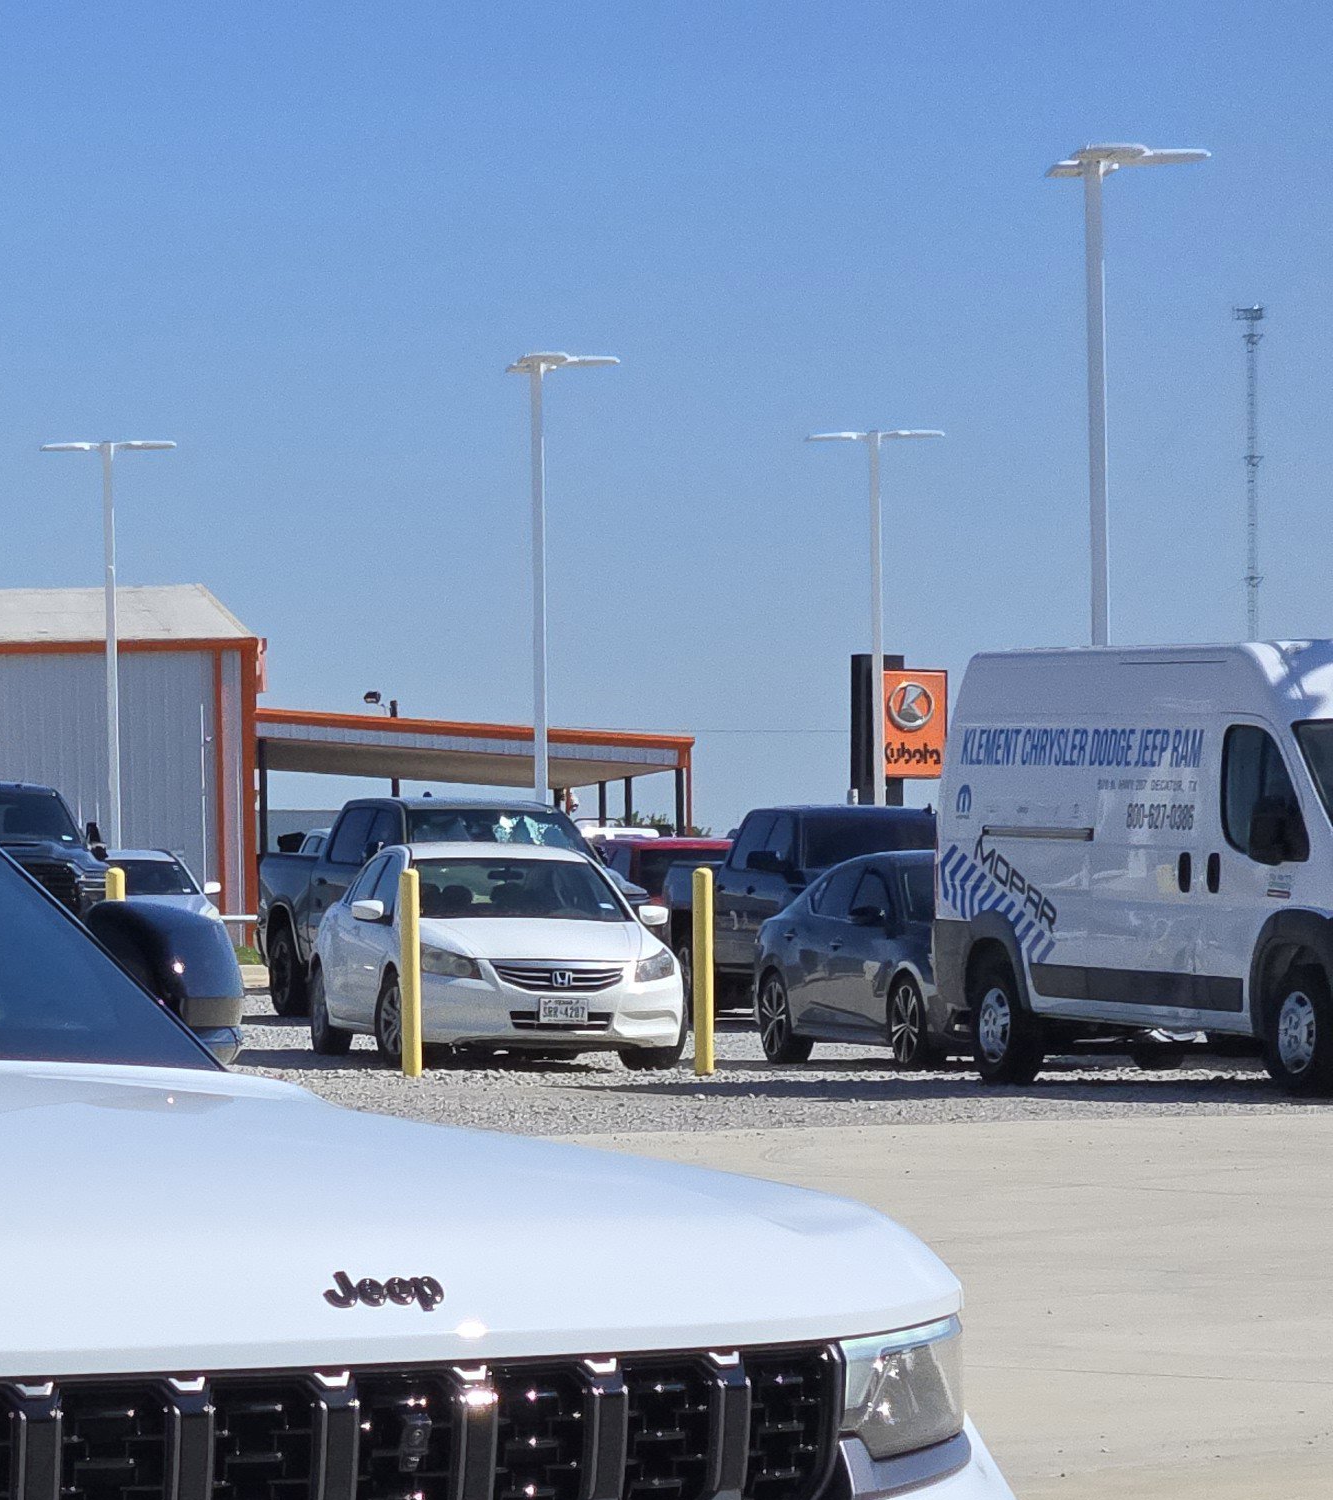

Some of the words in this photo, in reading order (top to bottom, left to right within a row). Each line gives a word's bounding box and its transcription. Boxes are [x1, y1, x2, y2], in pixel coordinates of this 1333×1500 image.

[960, 728, 1022, 765] KLEMENT
[1021, 728, 1089, 766] CHRYSLER
[1088, 728, 1136, 767] DODGE
[1134, 728, 1170, 767] JEEP
[1169, 729, 1205, 768] RAM
[974, 834, 1057, 934] MOPAR
[322, 1270, 445, 1312] Jeep
